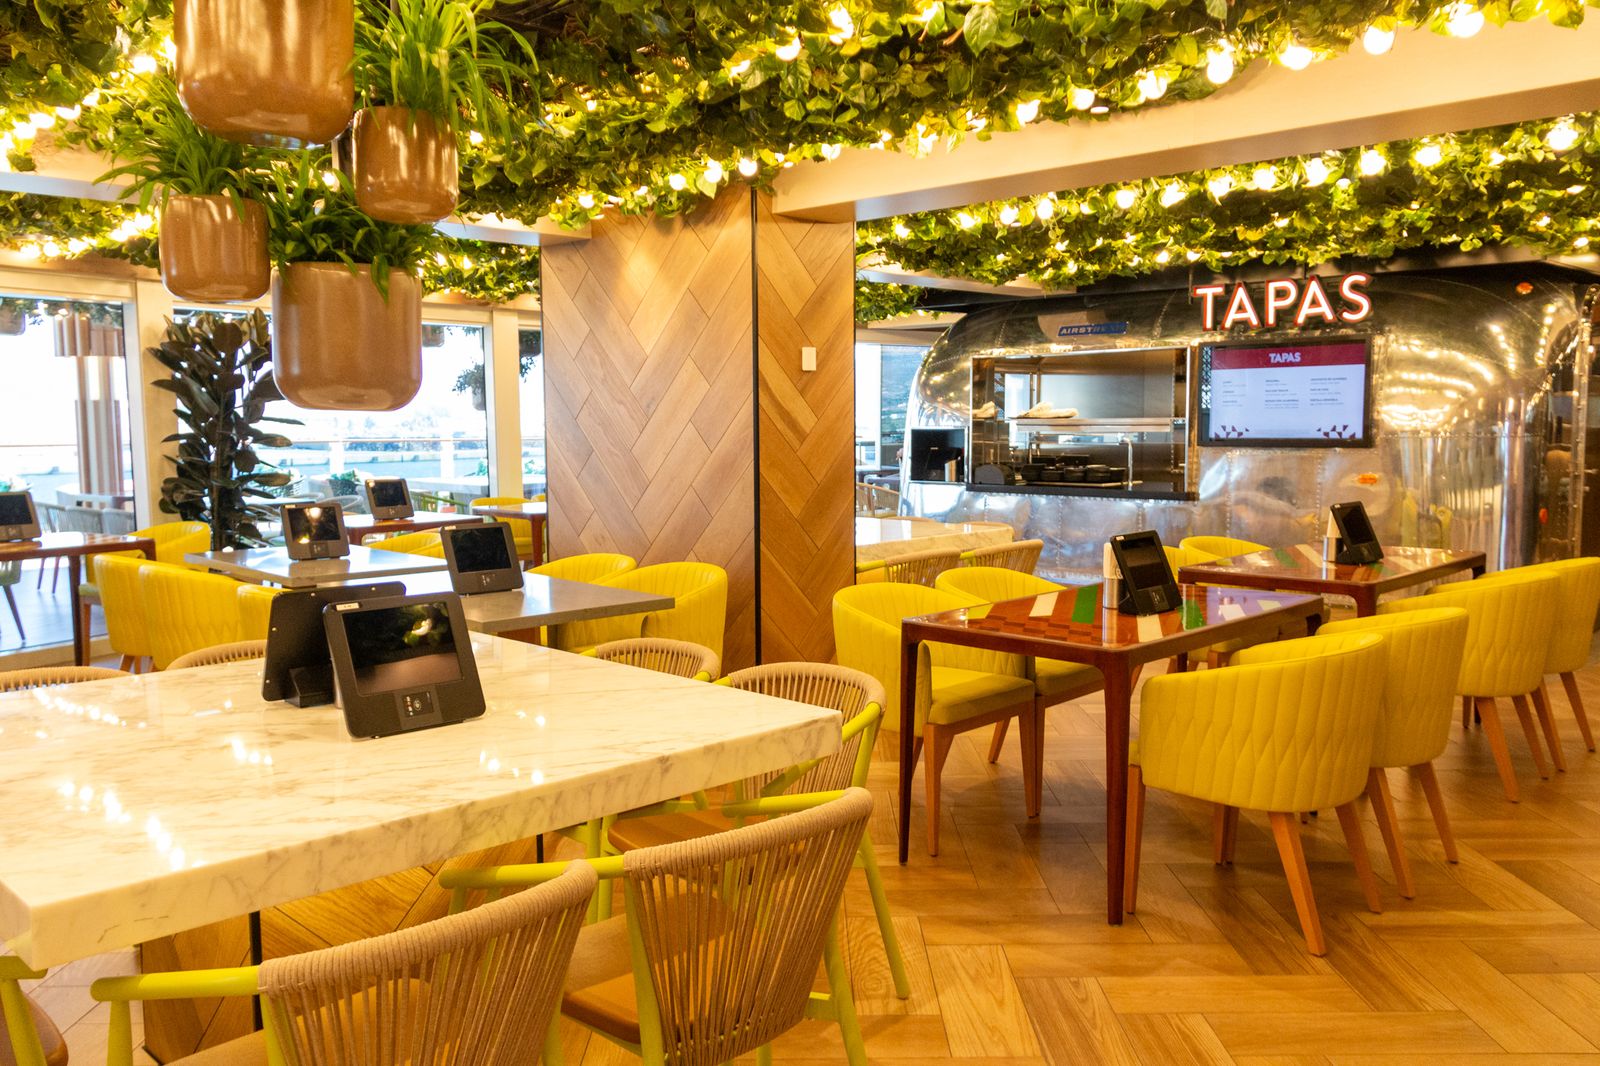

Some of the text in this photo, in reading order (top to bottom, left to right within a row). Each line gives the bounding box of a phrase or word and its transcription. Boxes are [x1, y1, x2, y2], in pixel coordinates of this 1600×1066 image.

[1193, 272, 1372, 331] TAPAS
[1060, 324, 1122, 335] AIRSTR
[1269, 352, 1302, 363] TAPAS
